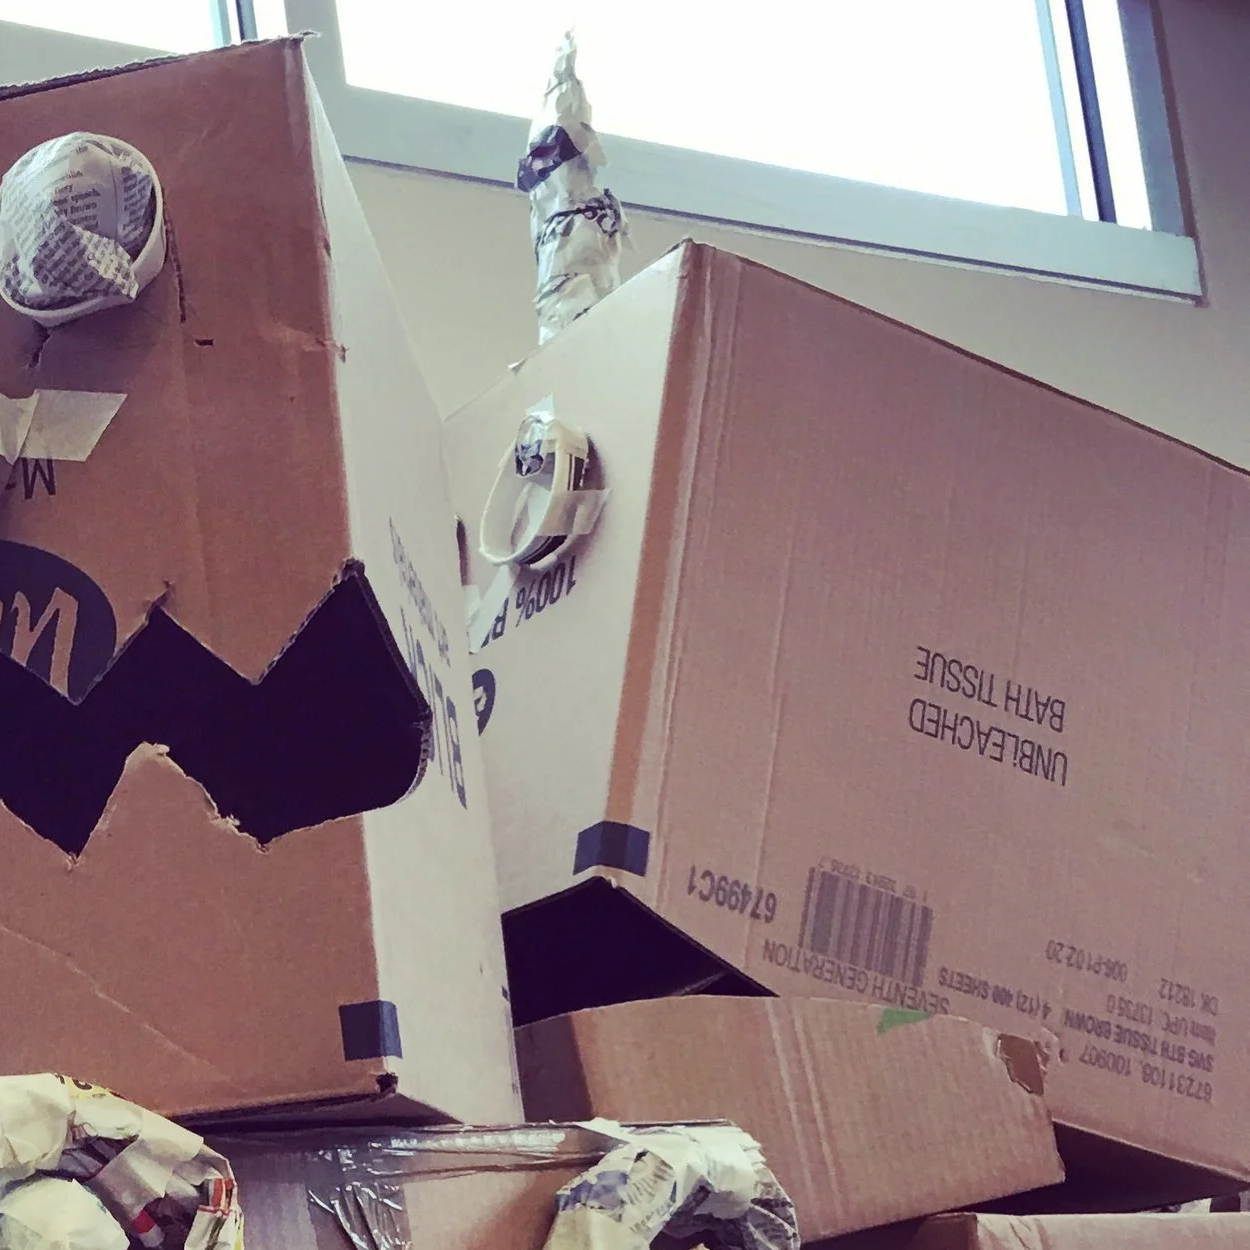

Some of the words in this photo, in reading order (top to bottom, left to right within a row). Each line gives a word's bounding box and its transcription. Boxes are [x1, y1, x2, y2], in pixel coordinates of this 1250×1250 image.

[515, 556, 577, 628] 100%
[913, 646, 998, 707] TISSUE
[1003, 681, 1066, 734] BATH
[908, 699, 1068, 787] UNBLEACHED
[686, 865, 778, 925] 67499C1
[761, 938, 870, 994] GENERATION
[937, 966, 990, 1001] SHEETS
[870, 975, 950, 1016] SEVENTH
[1063, 1007, 1112, 1040] BROWN
[1114, 1023, 1158, 1057] TISSUE
